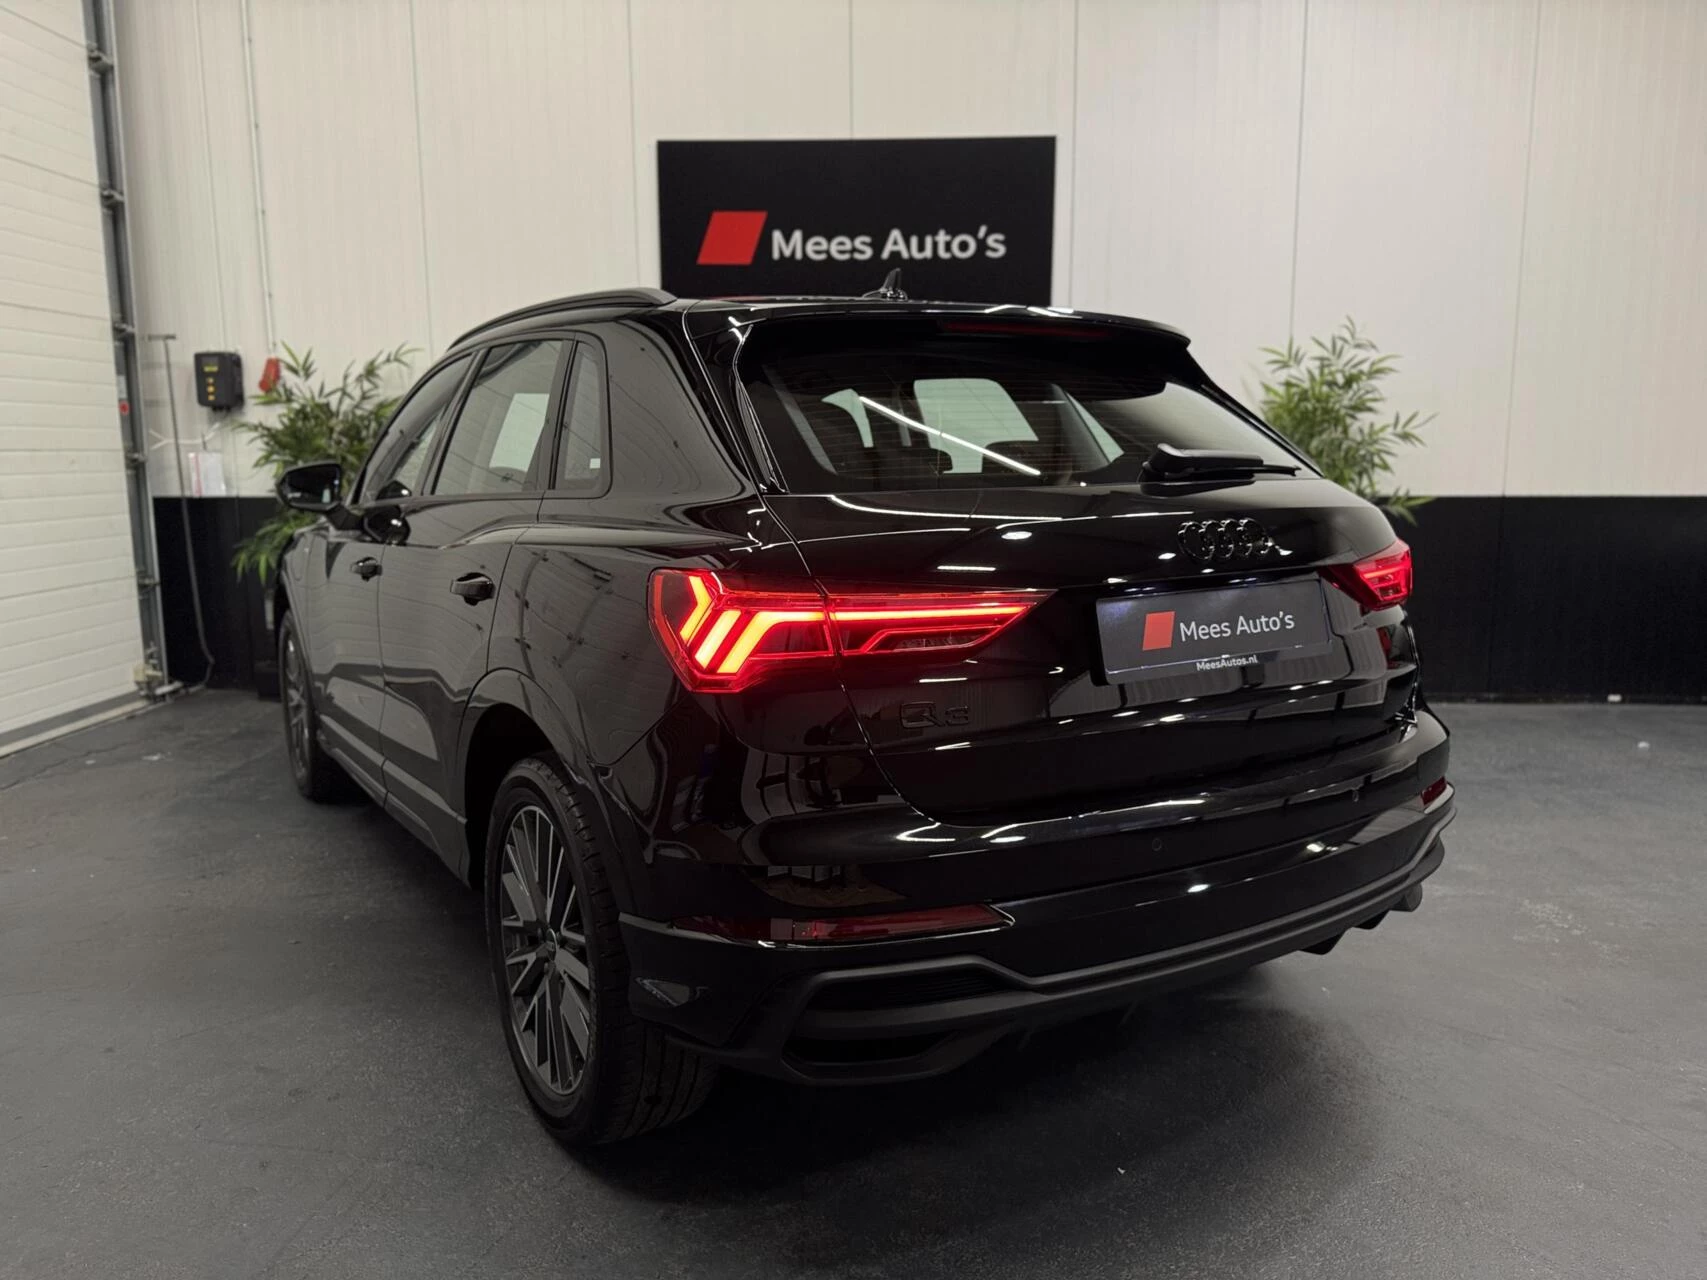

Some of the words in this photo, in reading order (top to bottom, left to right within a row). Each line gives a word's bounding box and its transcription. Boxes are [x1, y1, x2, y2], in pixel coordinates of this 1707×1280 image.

[771, 229, 873, 261] Mees
[880, 225, 1007, 260] Auto's
[1179, 620, 1231, 642] Mees
[1235, 611, 1295, 636] Auto's
[1196, 655, 1258, 671] MeesAutos.nl
